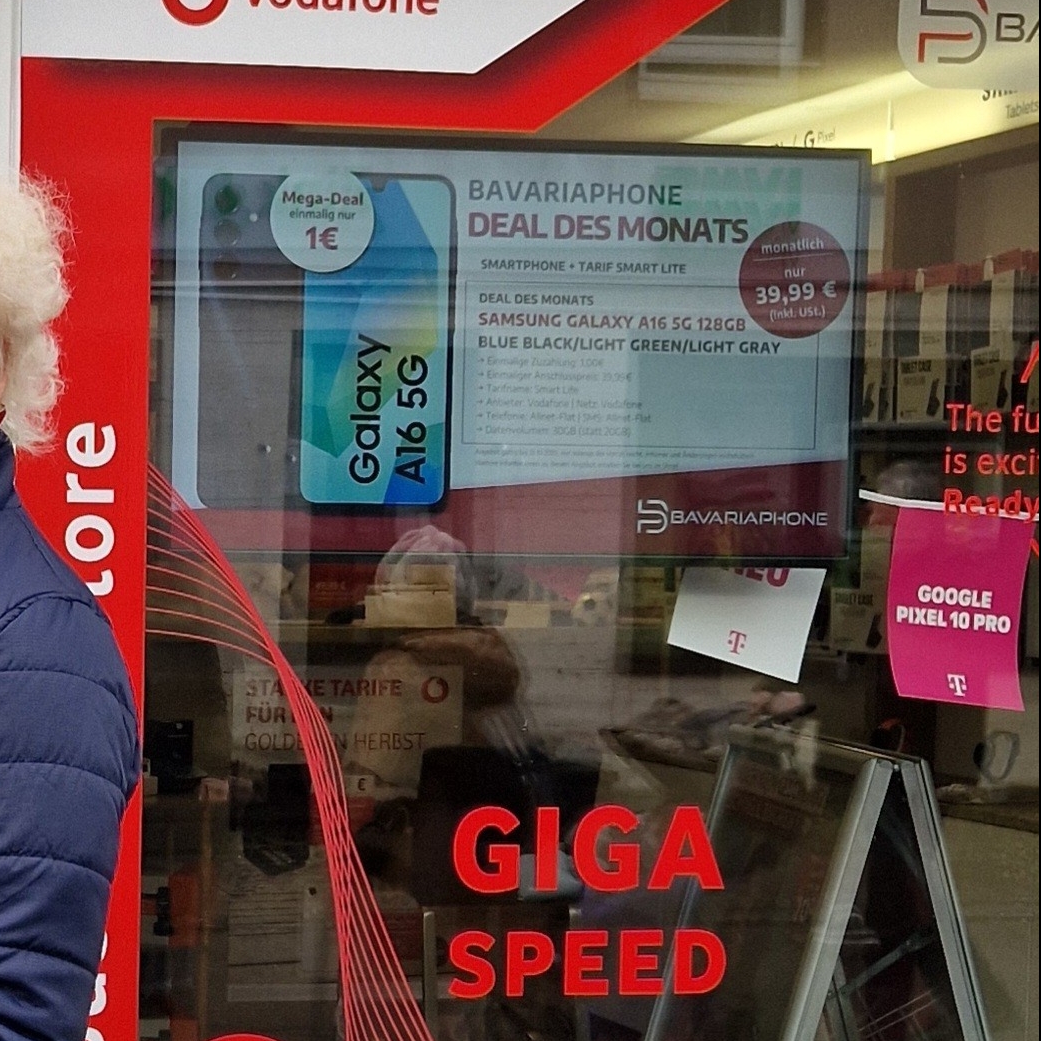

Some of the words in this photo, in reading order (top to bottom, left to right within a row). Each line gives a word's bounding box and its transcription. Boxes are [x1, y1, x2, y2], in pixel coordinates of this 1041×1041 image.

[282, 191, 364, 208] Mega-Deal
[468, 179, 682, 206] BAVARIAPHONE
[289, 209, 335, 222] einmalig
[338, 212, 356, 220] nur
[305, 226, 339, 250] 1€
[468, 212, 548, 239] DEAL
[554, 214, 610, 240] DES
[617, 215, 749, 244] MONATS
[761, 238, 824, 254] monatlich
[480, 259, 565, 272] SMARTPHONE
[578, 261, 612, 272] TARIF
[616, 262, 658, 274] SMART
[661, 263, 686, 275] LITE
[784, 267, 806, 278] nur
[479, 293, 510, 304] DEAL
[514, 293, 538, 305] DES
[541, 294, 594, 306] MONATS
[755, 282, 815, 306] 39,99
[822, 280, 838, 298] €
[478, 312, 561, 327] SAMSUNG
[566, 314, 633, 329] GALAXY
[638, 316, 667, 330] A16
[671, 316, 691, 330] 5G
[696, 317, 746, 331] 128GB
[478, 336, 518, 349] BLUE
[522, 336, 626, 351] BLACK/LIGHT
[630, 338, 735, 354] GREEN/LIGHT
[739, 340, 781, 354] GRAY
[397, 354, 428, 409] 5G
[349, 333, 391, 484] Galaxy
[946, 403, 1002, 433] The
[395, 421, 427, 485] A16
[944, 446, 967, 474] is
[977, 448, 1039, 475] exci
[670, 510, 828, 526] BAVARIAPHONE
[918, 585, 993, 609] GOOGLE
[896, 605, 947, 627] PIXEL
[949, 611, 970, 629] 10
[973, 613, 1011, 633] PRO
[246, 679, 324, 697] STAKE
[330, 679, 402, 697] TARIFE
[246, 702, 286, 724] FÜR
[354, 733, 425, 750] HERBST
[453, 805, 725, 893] GIGA
[448, 929, 727, 999] SPEED
